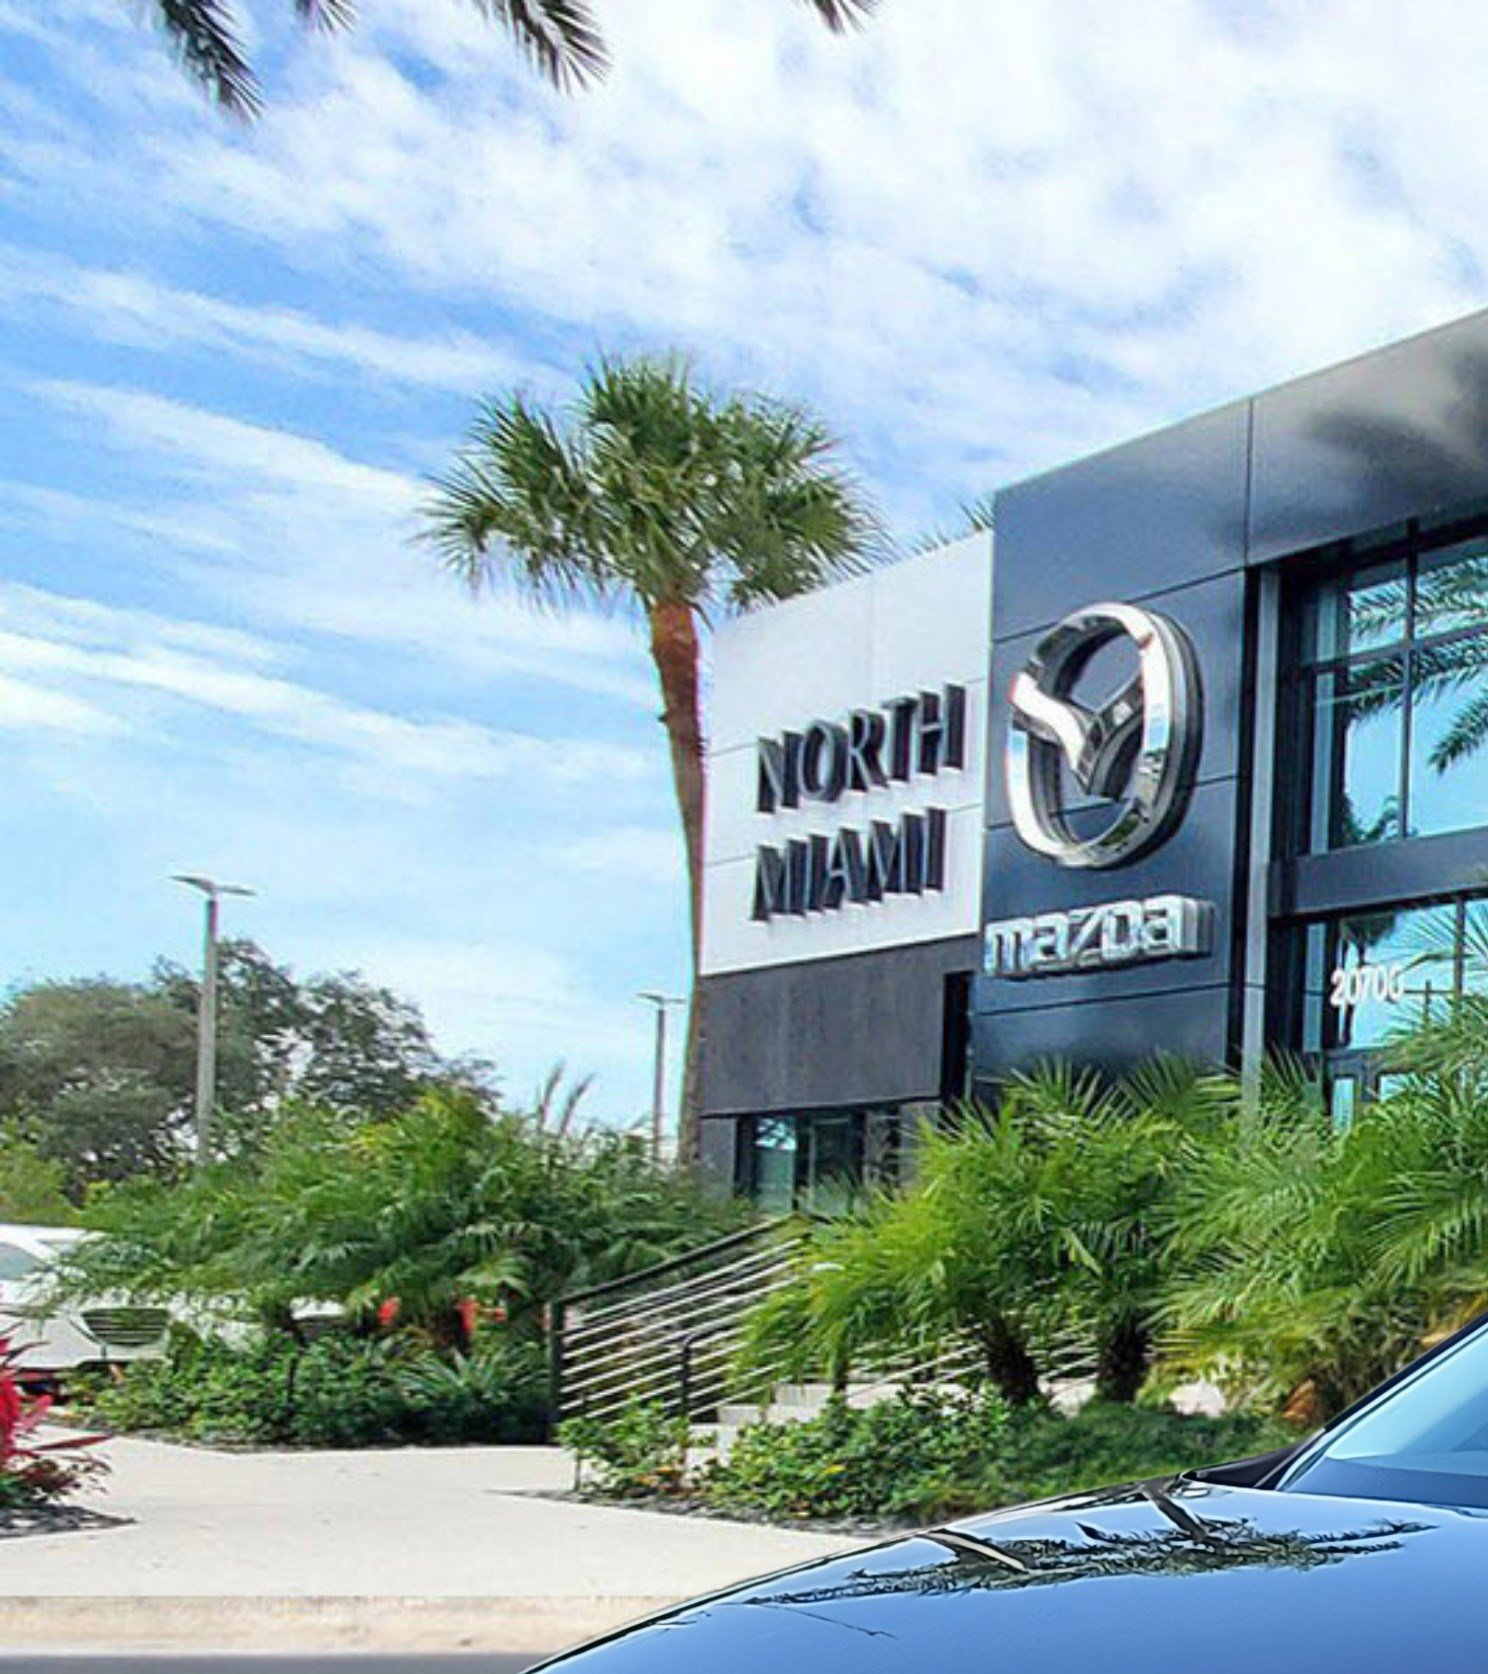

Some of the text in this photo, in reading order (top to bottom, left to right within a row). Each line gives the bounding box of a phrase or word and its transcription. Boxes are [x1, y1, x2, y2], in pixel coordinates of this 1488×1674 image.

[757, 682, 967, 814] NORTH
[751, 807, 947, 922] MIAMI
[983, 894, 1206, 977] mazda
